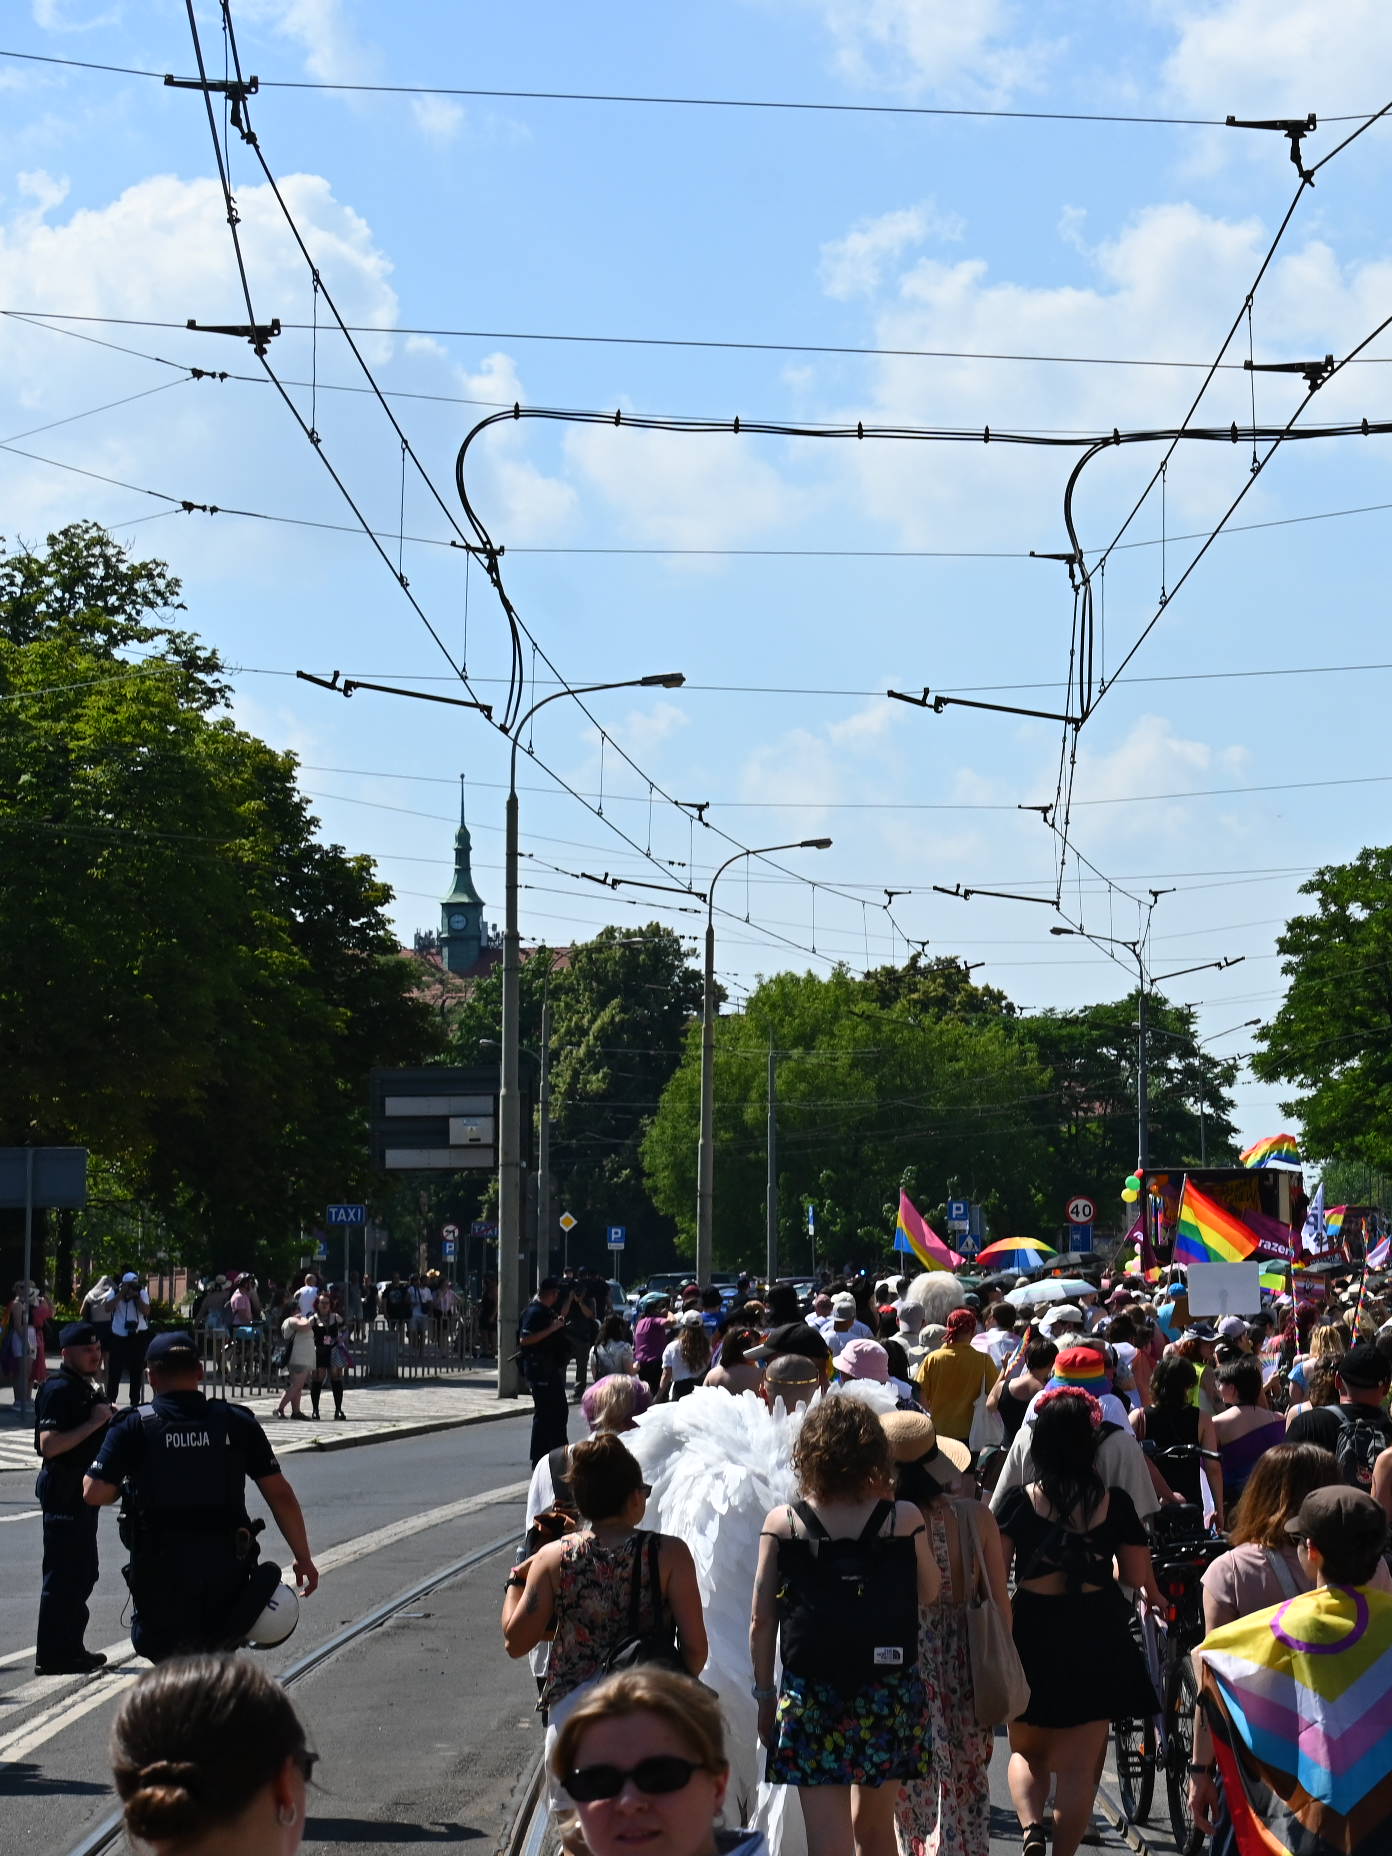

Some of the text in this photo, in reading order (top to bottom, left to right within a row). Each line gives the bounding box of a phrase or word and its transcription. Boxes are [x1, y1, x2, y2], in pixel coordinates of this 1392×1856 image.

[329, 1206, 362, 1223] TAXI
[1070, 1204, 1092, 1218] 40
[166, 1431, 209, 1449] POLICJA
